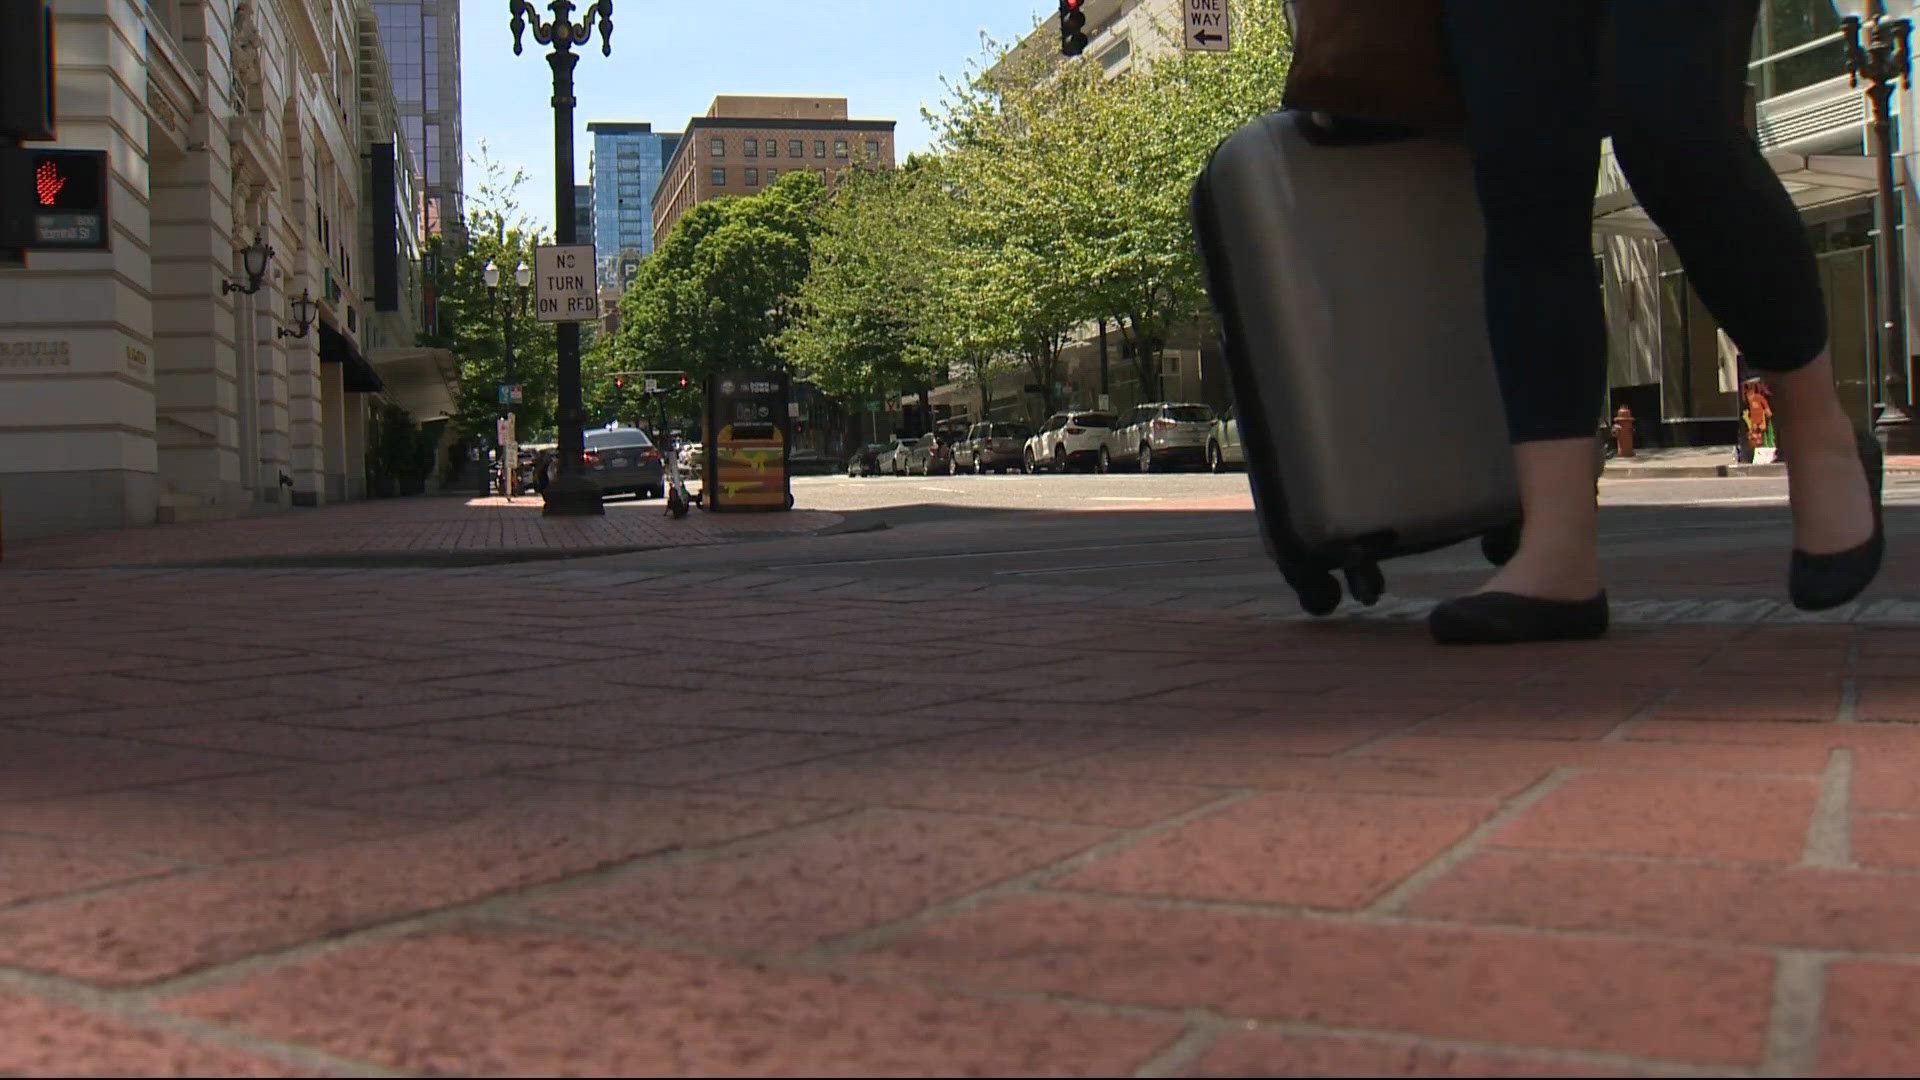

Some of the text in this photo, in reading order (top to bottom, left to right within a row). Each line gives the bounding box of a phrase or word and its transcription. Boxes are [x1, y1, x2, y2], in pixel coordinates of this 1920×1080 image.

[1191, 0, 1220, 11] ONE
[1191, 12, 1221, 26] WAY
[557, 254, 576, 269] NO
[547, 275, 584, 291] TURN
[540, 297, 594, 314] ON RED
